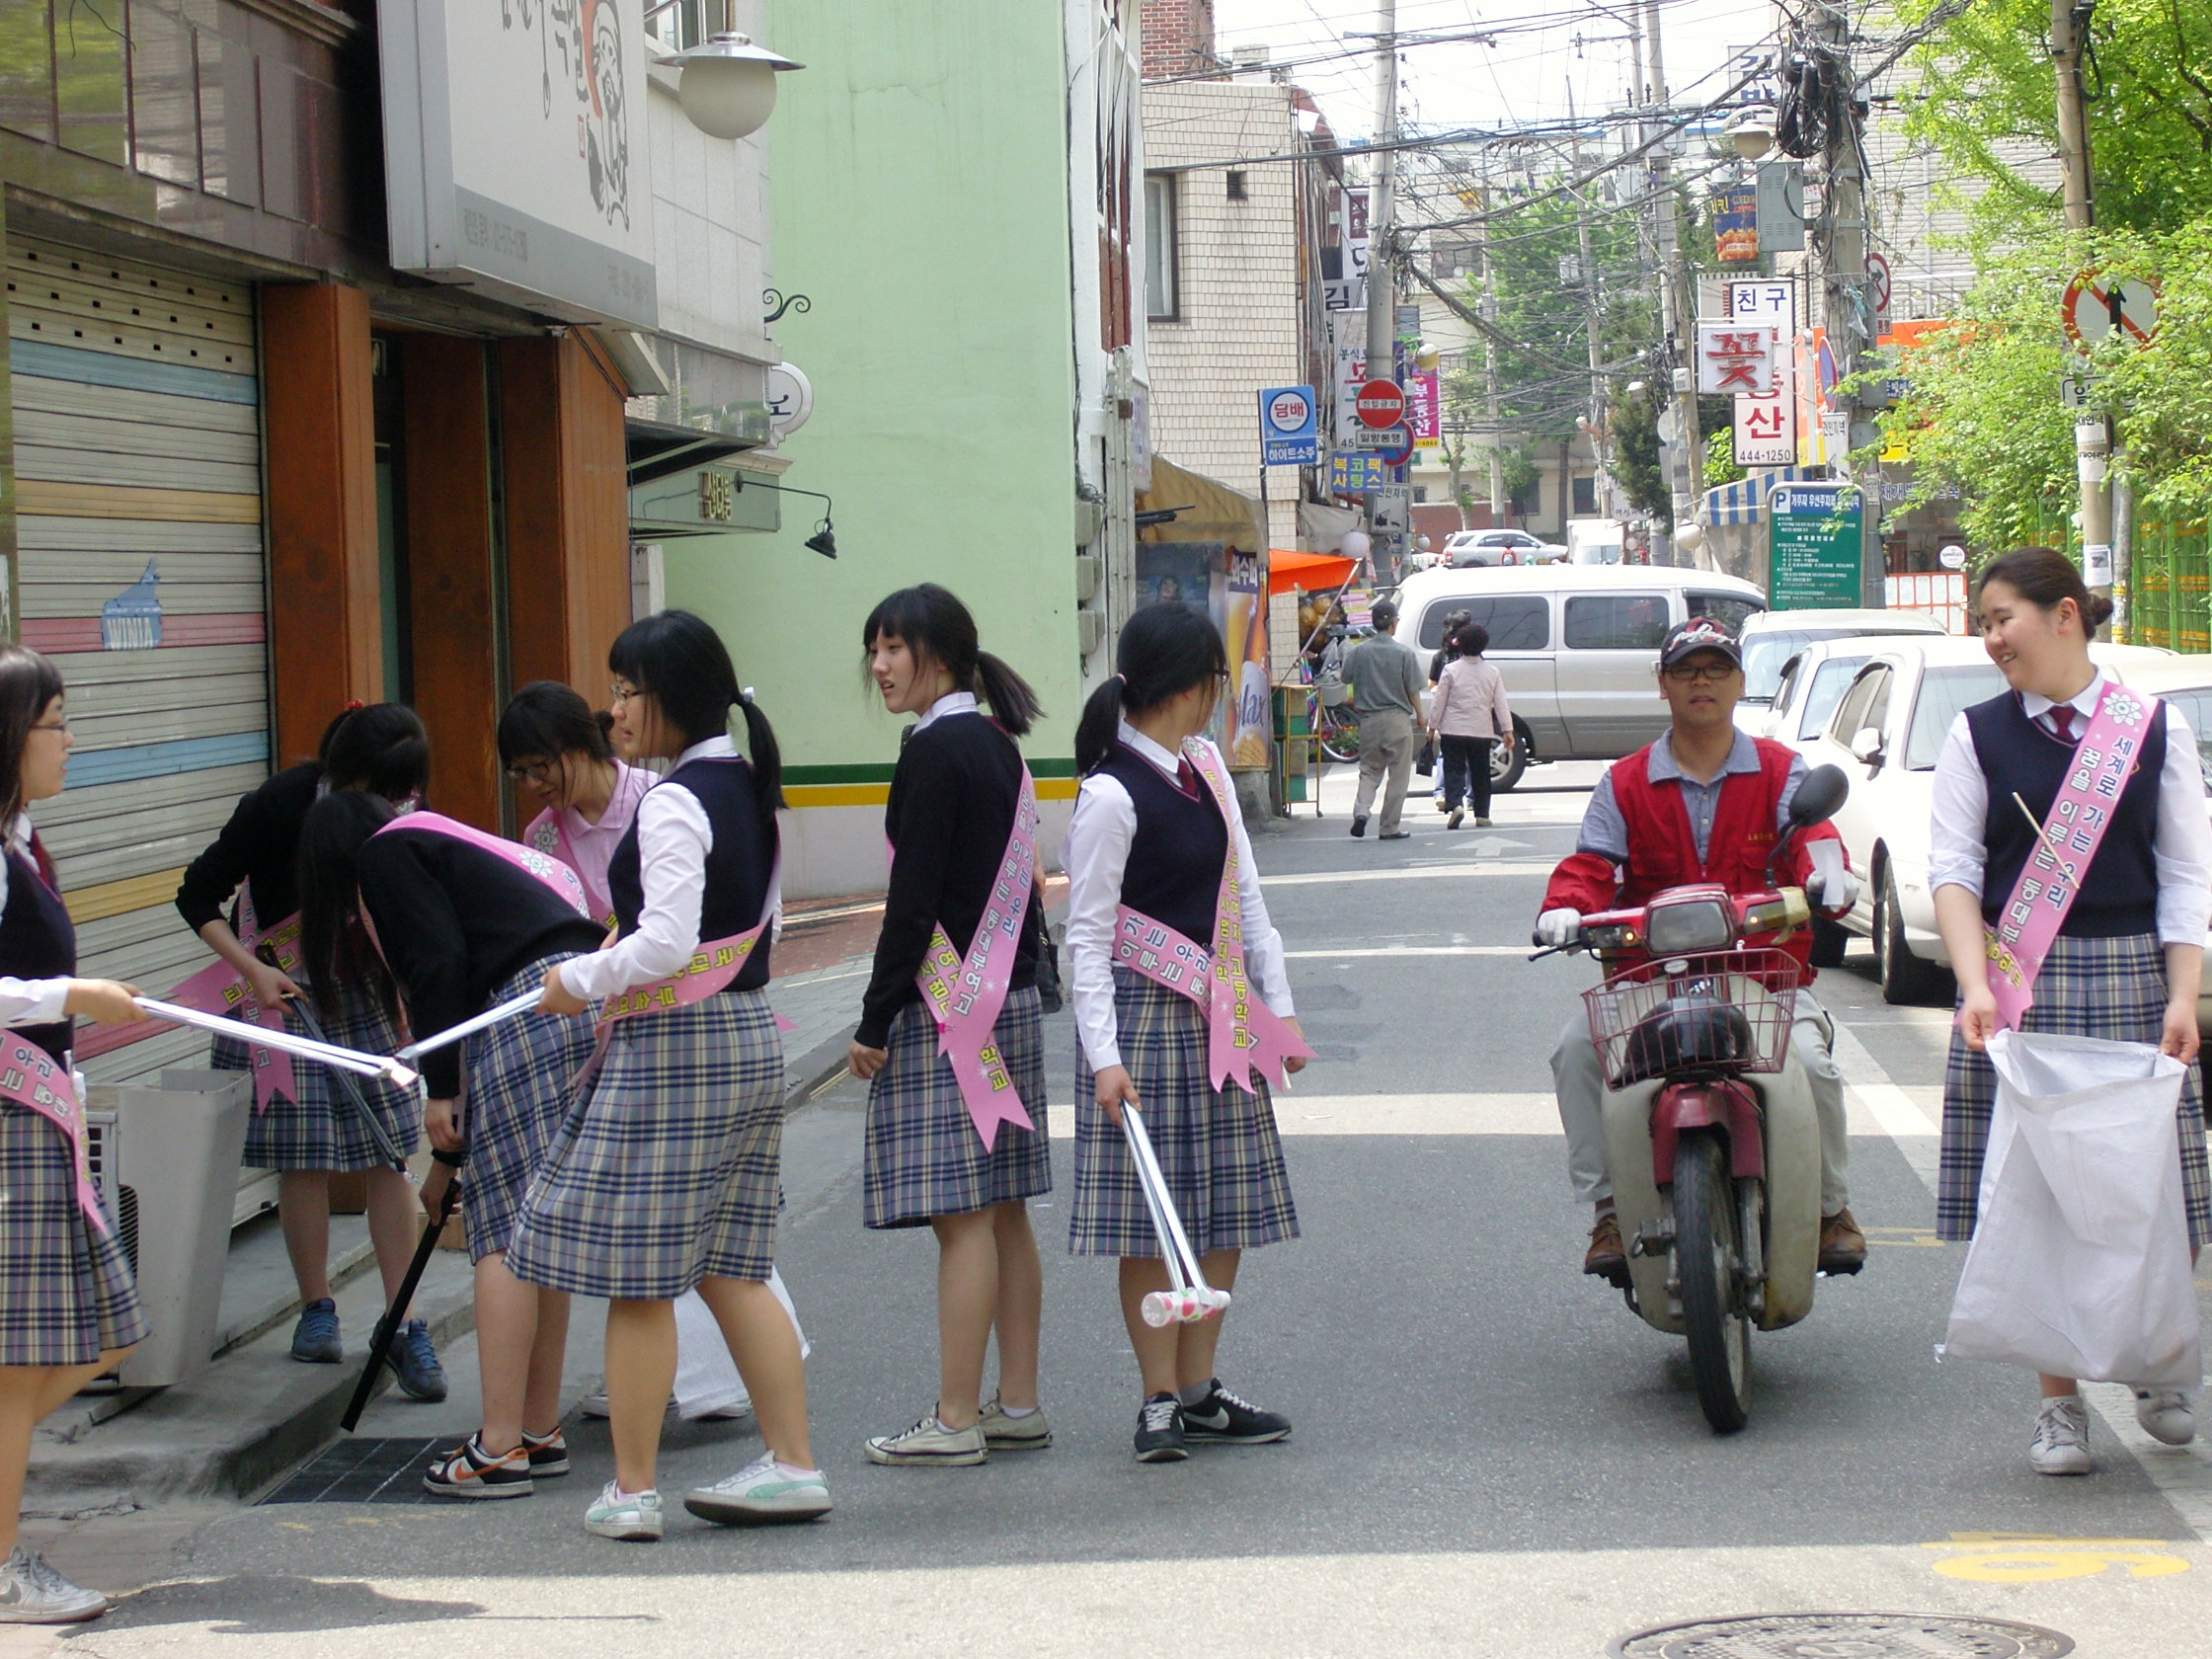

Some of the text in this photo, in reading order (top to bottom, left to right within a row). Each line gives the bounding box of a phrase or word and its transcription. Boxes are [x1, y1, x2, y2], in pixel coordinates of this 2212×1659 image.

[1737, 287, 1787, 313] 친구
[1705, 331, 1767, 388] 꽃
[1274, 402, 1304, 419] 담배
[1363, 399, 1398, 410] 진입금지
[1413, 383, 1432, 436] 부동산
[1268, 446, 1315, 461] 하이트소주
[1360, 433, 1401, 443] 일방통행
[1739, 448, 1791, 463] 444-1250
[1776, 492, 1786, 509] P
[1791, 494, 1808, 508] 거주자
[2044, 735, 2135, 911] 세계로 가는 우리
[2001, 747, 2102, 945] 꿈을 이루는 동대부
[995, 836, 1025, 903] 이루는
[1000, 896, 1024, 940] 우리
[953, 907, 1001, 1017] 동대부여고
[1118, 938, 1185, 985] 이루는
[1123, 915, 1211, 973] 가는 우리
[1230, 954, 1248, 1049] 고등학교
[15, 1048, 54, 1082] 우리
